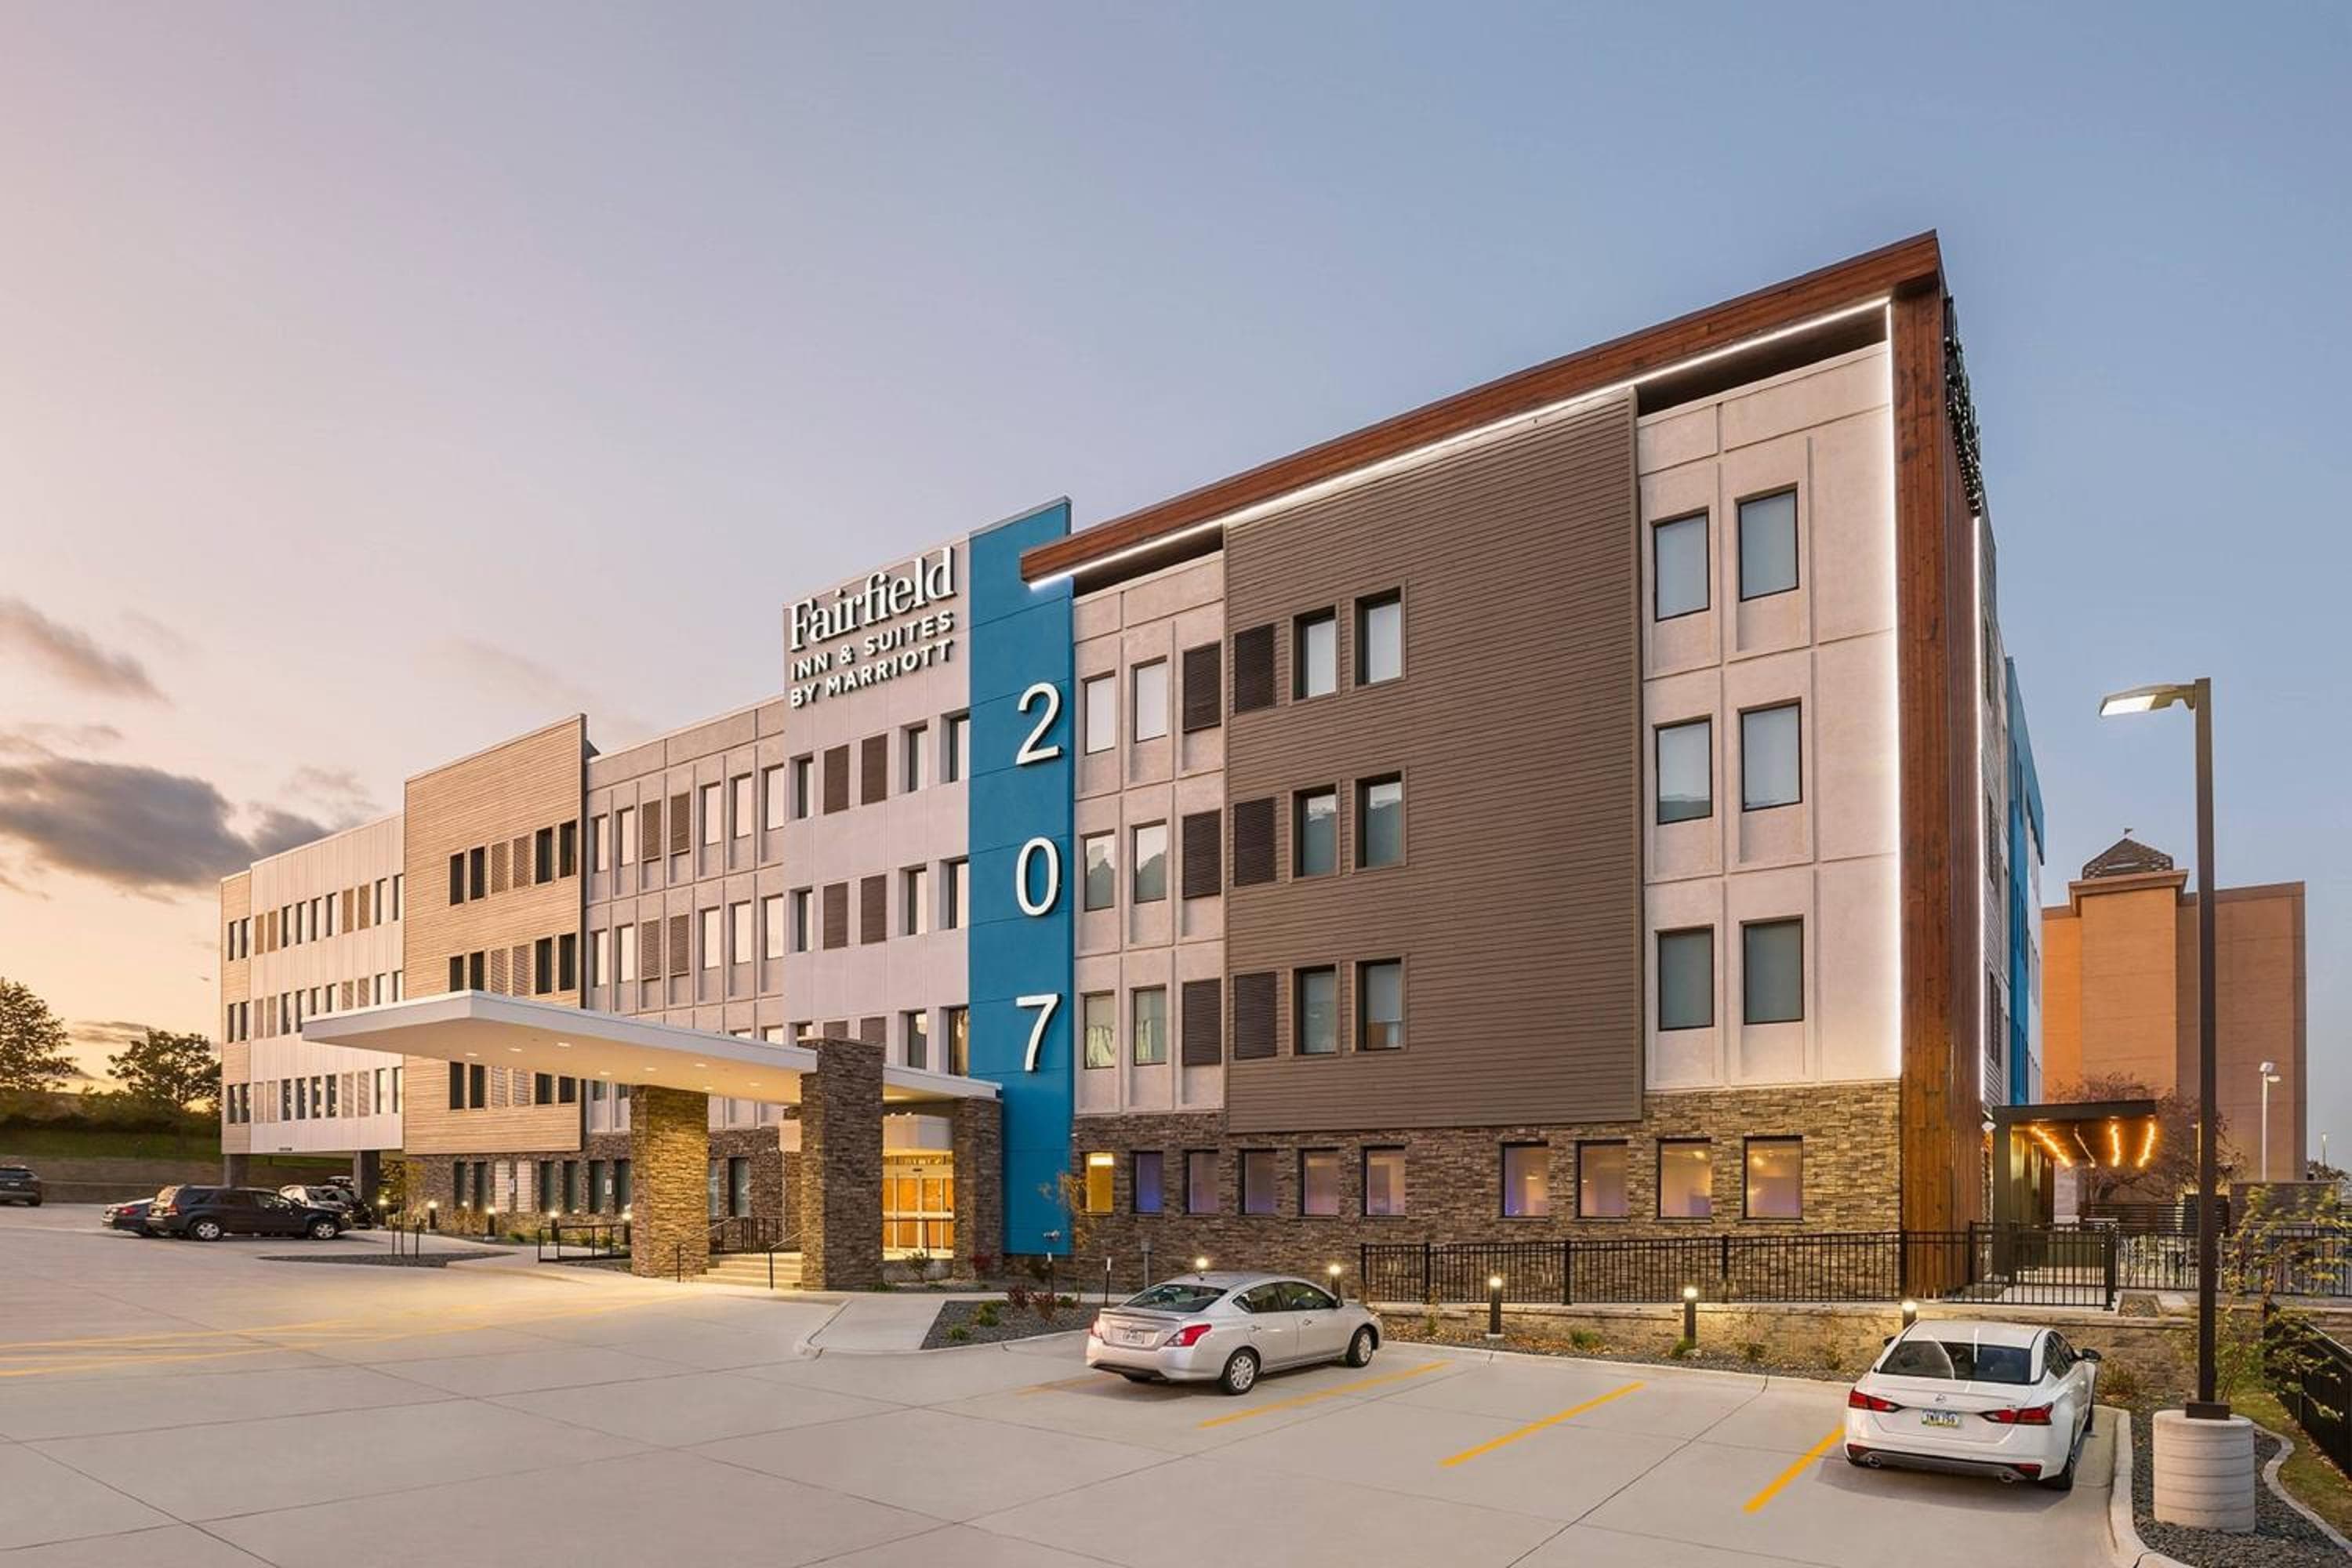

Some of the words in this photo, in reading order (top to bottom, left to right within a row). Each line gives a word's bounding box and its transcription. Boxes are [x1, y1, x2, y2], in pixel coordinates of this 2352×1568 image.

[789, 545, 956, 652] Fairfield
[790, 652, 829, 681] INN
[839, 644, 853, 665] &
[864, 609, 953, 656] SUITES
[790, 683, 818, 709] BY
[826, 639, 953, 697] MARRIOTT
